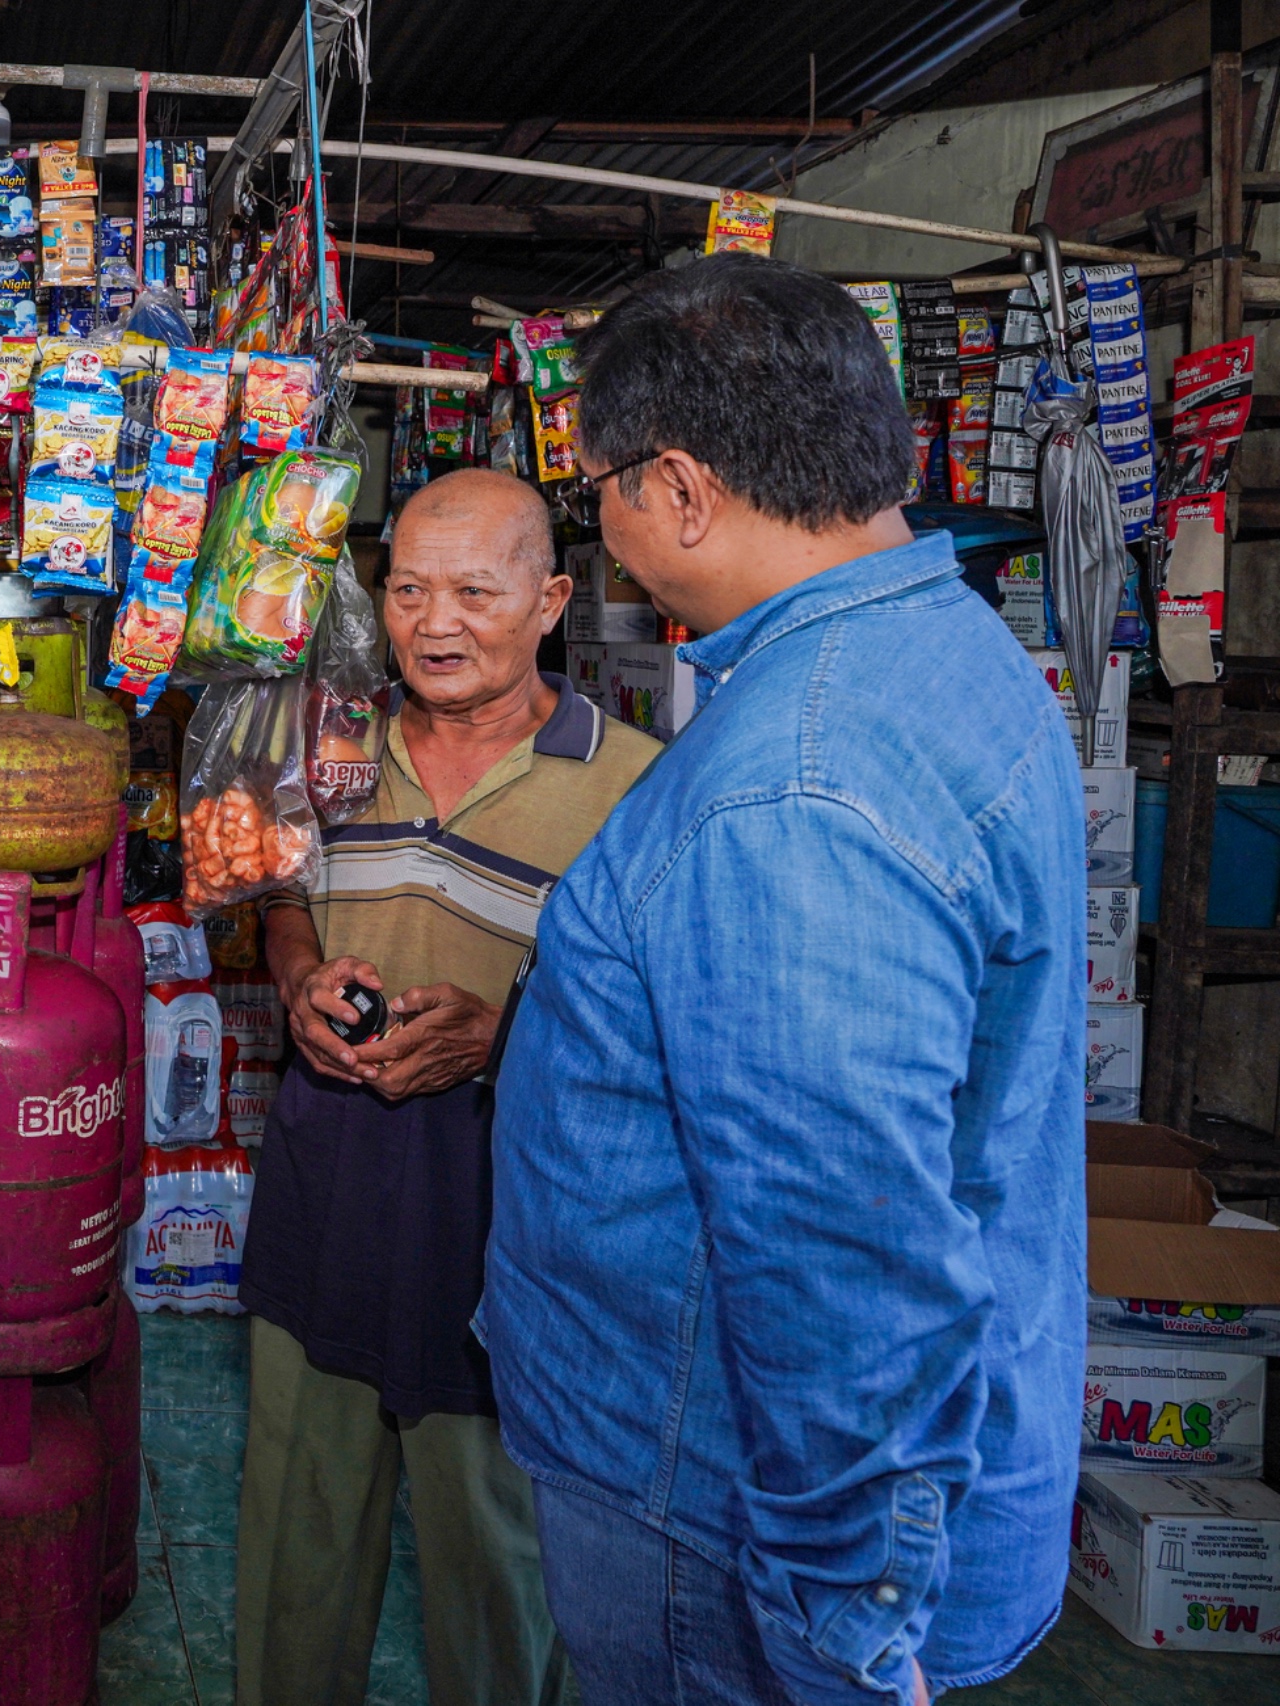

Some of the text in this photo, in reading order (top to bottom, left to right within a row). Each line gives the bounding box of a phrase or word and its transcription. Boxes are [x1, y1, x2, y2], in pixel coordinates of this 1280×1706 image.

[1086, 264, 1133, 282] PANTENE
[1, 279, 33, 292] Night
[1093, 302, 1138, 317] PANTENE
[1097, 343, 1142, 358] PANTENE
[1175, 366, 1201, 381] Gillette
[1101, 382, 1147, 399] PANTENE
[1208, 410, 1239, 425] Gillette
[54, 423, 107, 435] KACANG KORO
[1104, 424, 1149, 440] PANTENE
[288, 463, 327, 478] CHOCHO
[1176, 503, 1211, 518] Gillette
[44, 519, 75, 529] KACANG
[1158, 601, 1205, 613] Gillette
[323, 763, 380, 788] oklat
[18, 1082, 122, 1137] Bright
[1163, 1319, 1249, 1337] Water For Life
[1086, 1365, 1227, 1381] Air Minum Dalam Kemasan
[1099, 1398, 1213, 1449] MAS
[1133, 1446, 1217, 1462] Water For Life
[1218, 1549, 1267, 1560] Diproduksi
[1185, 1602, 1259, 1634] MAS
